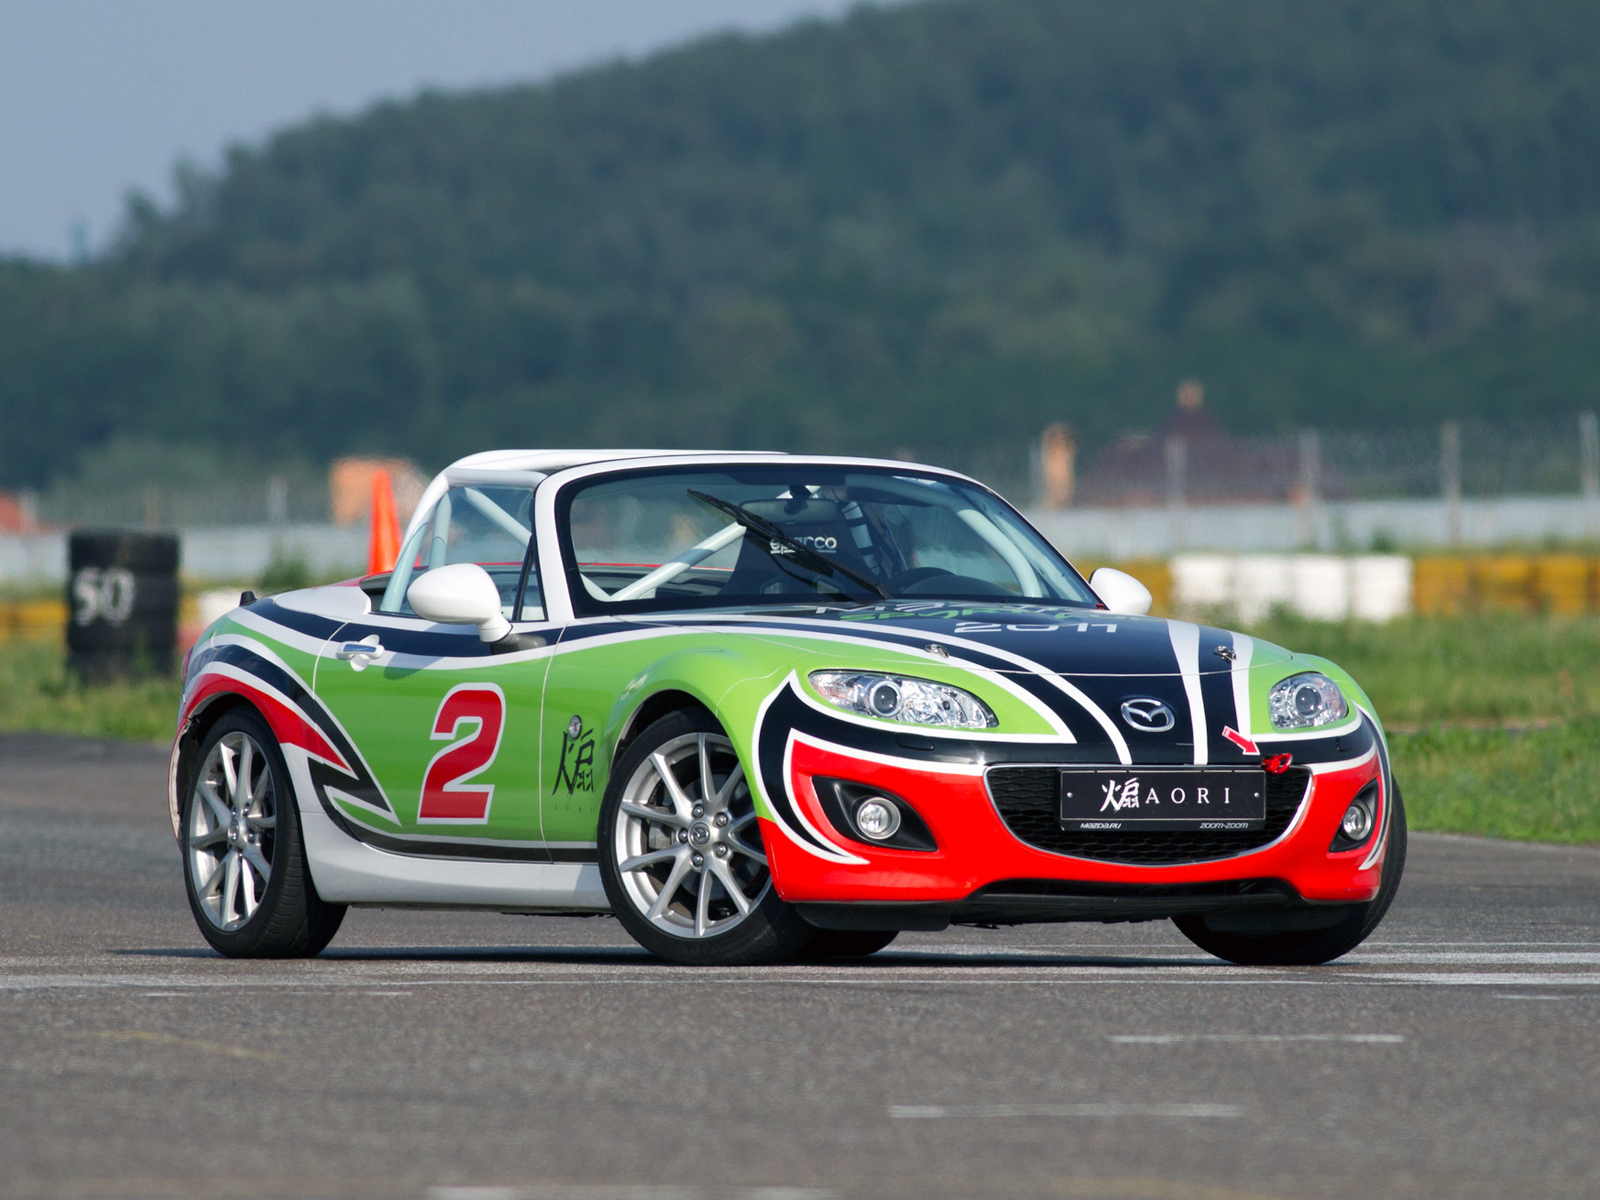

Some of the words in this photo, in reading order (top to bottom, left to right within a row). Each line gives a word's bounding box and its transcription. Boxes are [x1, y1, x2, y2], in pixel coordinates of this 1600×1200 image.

[73, 567, 135, 627] 50
[954, 622, 1118, 634] 2011
[417, 682, 506, 824] 2
[1145, 787, 1230, 804] AORI
